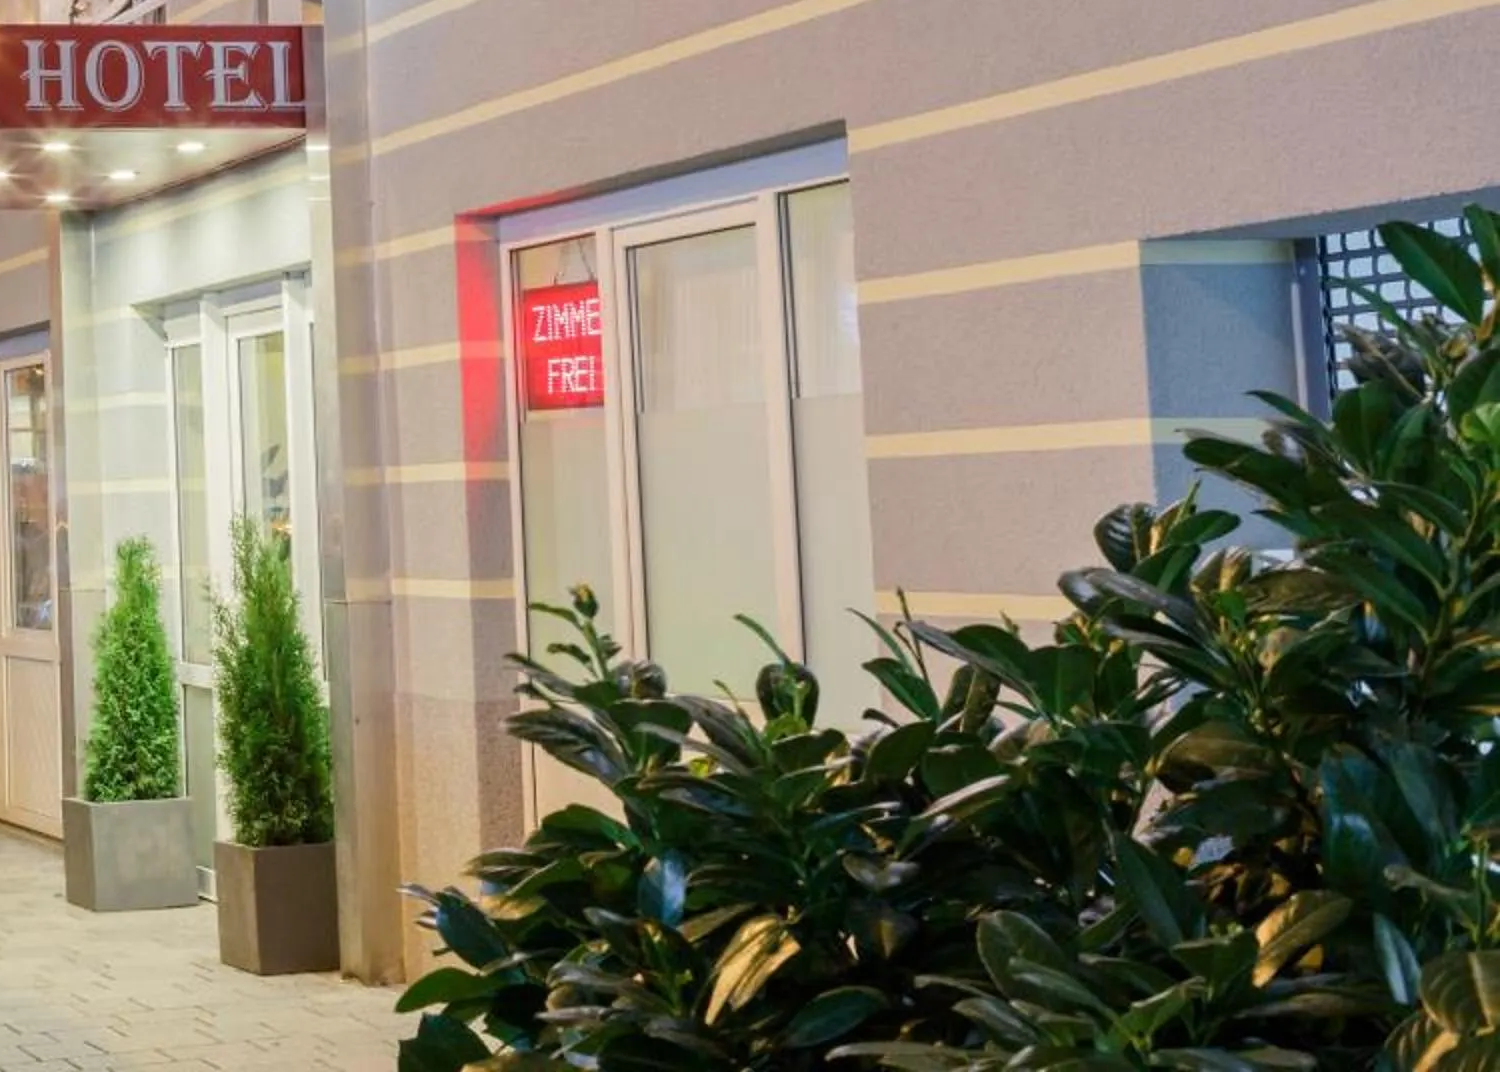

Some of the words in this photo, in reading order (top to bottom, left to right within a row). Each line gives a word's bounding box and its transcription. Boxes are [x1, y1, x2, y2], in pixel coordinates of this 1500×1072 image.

[20, 39, 306, 113] HOTEL
[532, 298, 602, 342] ZIMME
[548, 355, 596, 393] FREI
